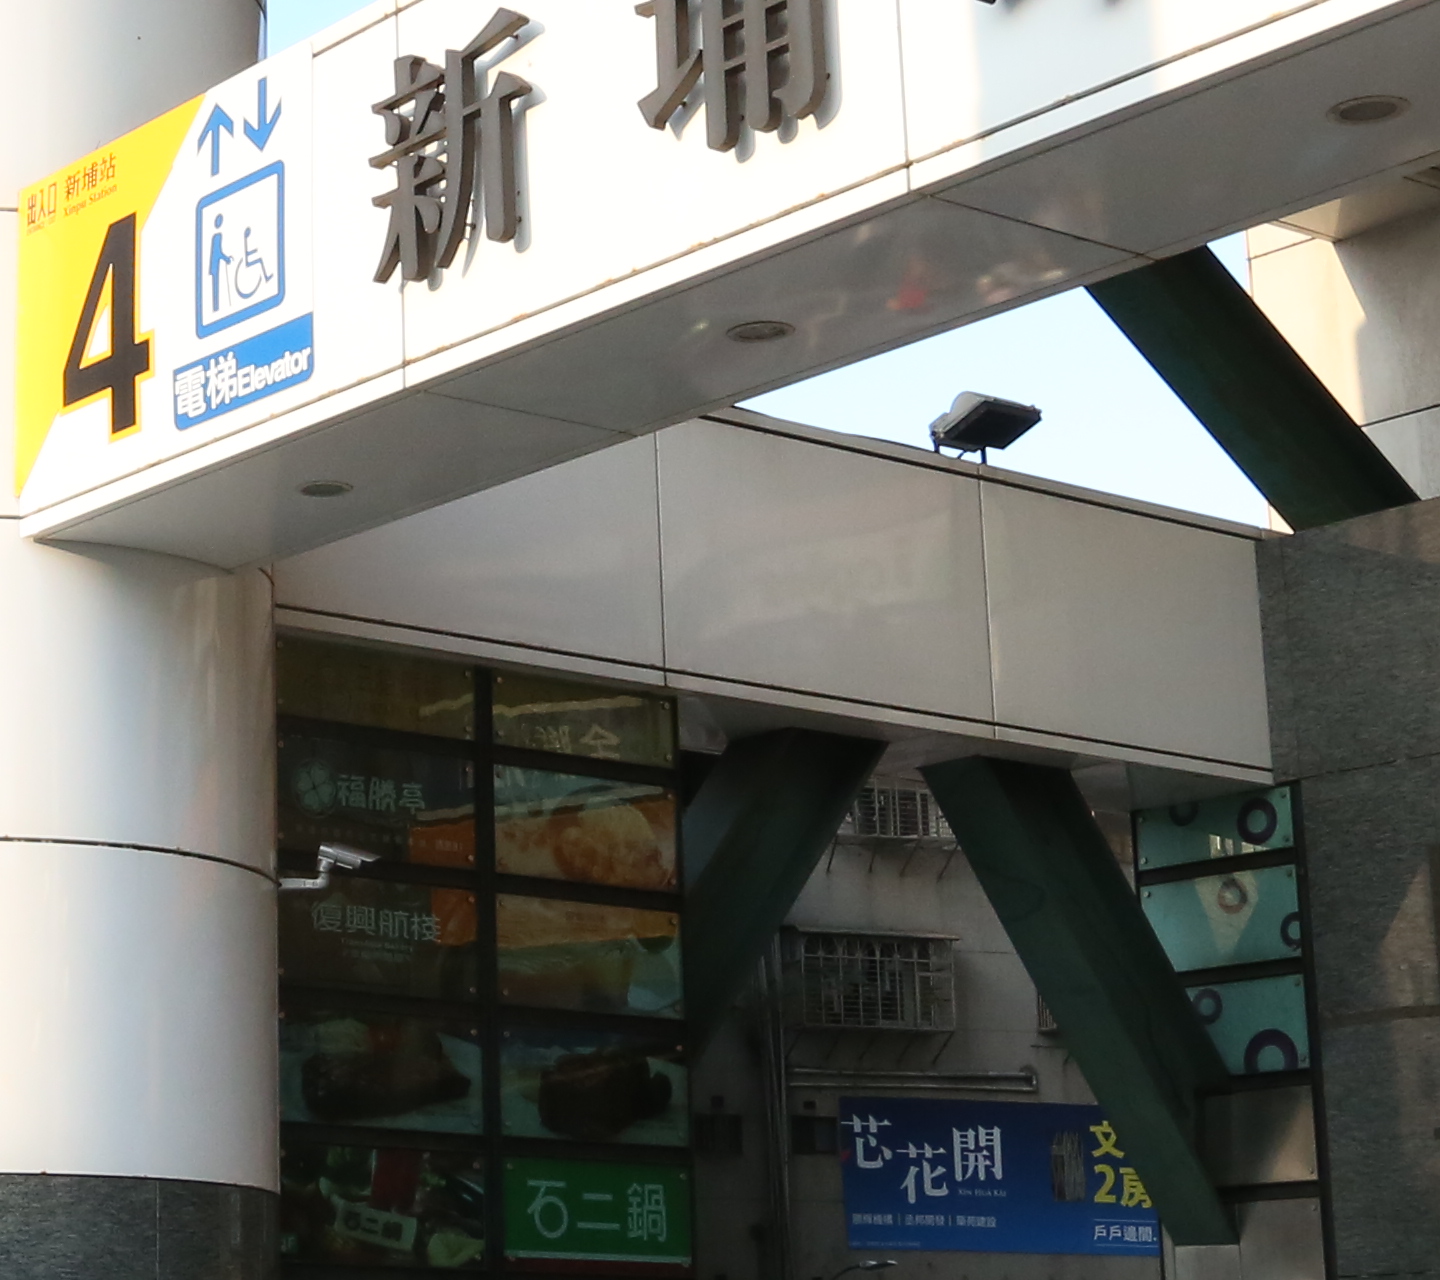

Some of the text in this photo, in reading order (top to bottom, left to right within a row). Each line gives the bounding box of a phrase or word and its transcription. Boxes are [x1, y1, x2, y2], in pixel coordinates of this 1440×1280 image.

[27, 182, 57, 226] 出入口
[64, 152, 117, 201] 新埔站
[63, 212, 151, 436] 4
[175, 346, 311, 419] 電梯 Elevator
[840, 1113, 1003, 1204] 芯花開
[526, 1179, 667, 1244] 石二鍋
